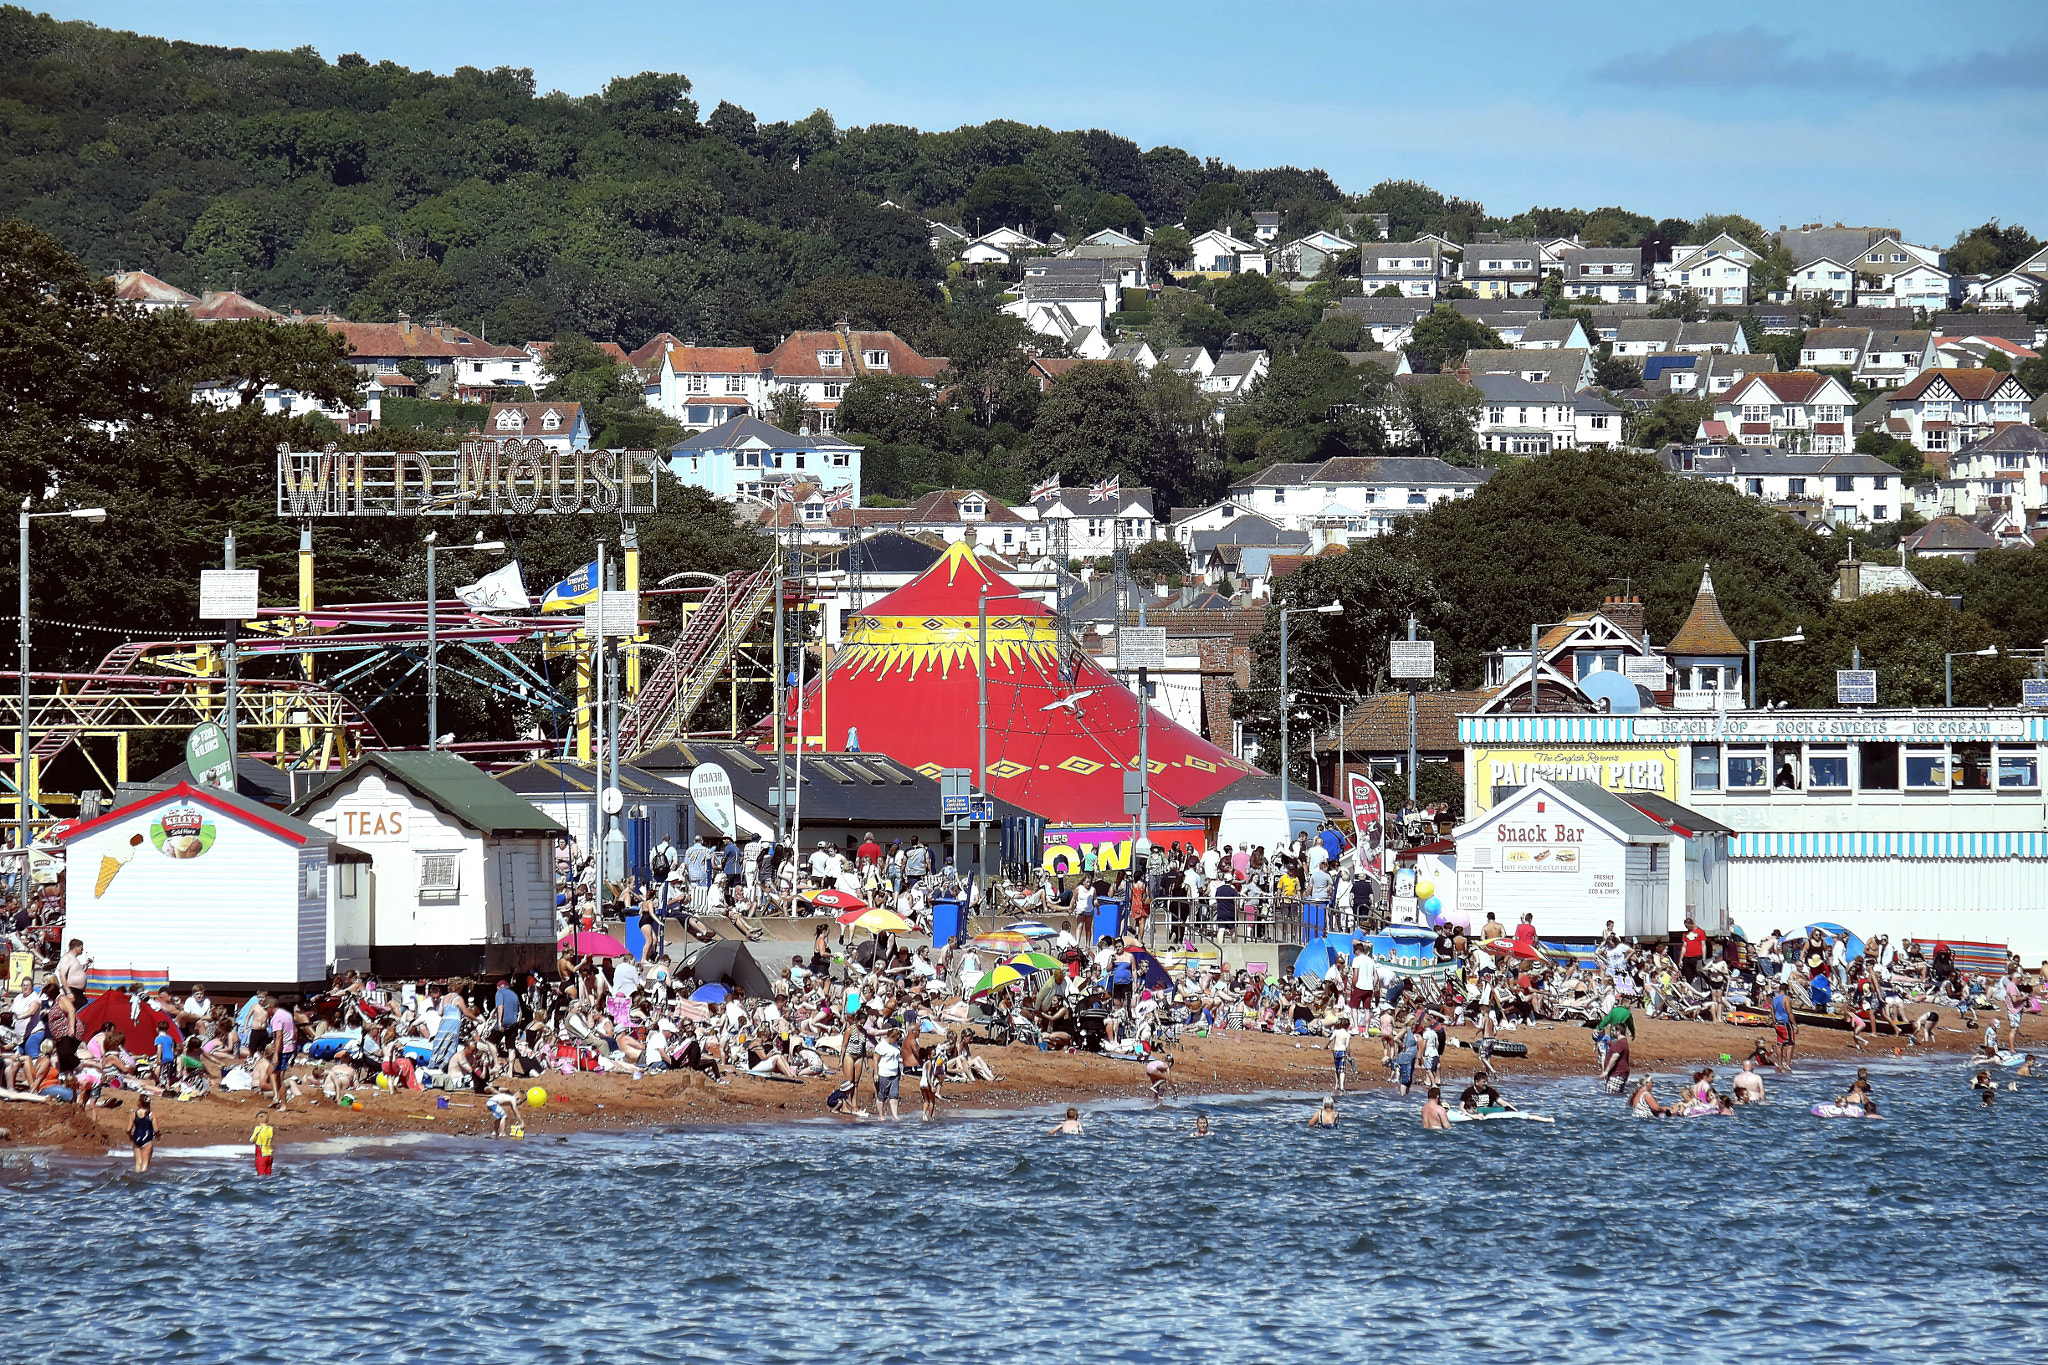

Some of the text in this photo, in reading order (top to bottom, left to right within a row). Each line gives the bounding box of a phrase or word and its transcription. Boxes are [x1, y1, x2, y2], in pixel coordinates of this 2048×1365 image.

[276, 438, 657, 516] WILD MOUSE
[1661, 721, 1708, 733] BEACH
[1776, 721, 1813, 733] ROCK
[1818, 722, 1826, 733] &
[1830, 721, 1887, 733] SWEETS
[1912, 722, 1935, 734] ICE
[1939, 722, 1991, 734] CREAM
[1534, 753, 1553, 762] The
[1554, 753, 1585, 764] English
[1609, 760, 1665, 791] PIER
[165, 815, 200, 826] KELLY'S
[344, 811, 402, 835] TEAS
[1497, 824, 1584, 842] Snack Bar
